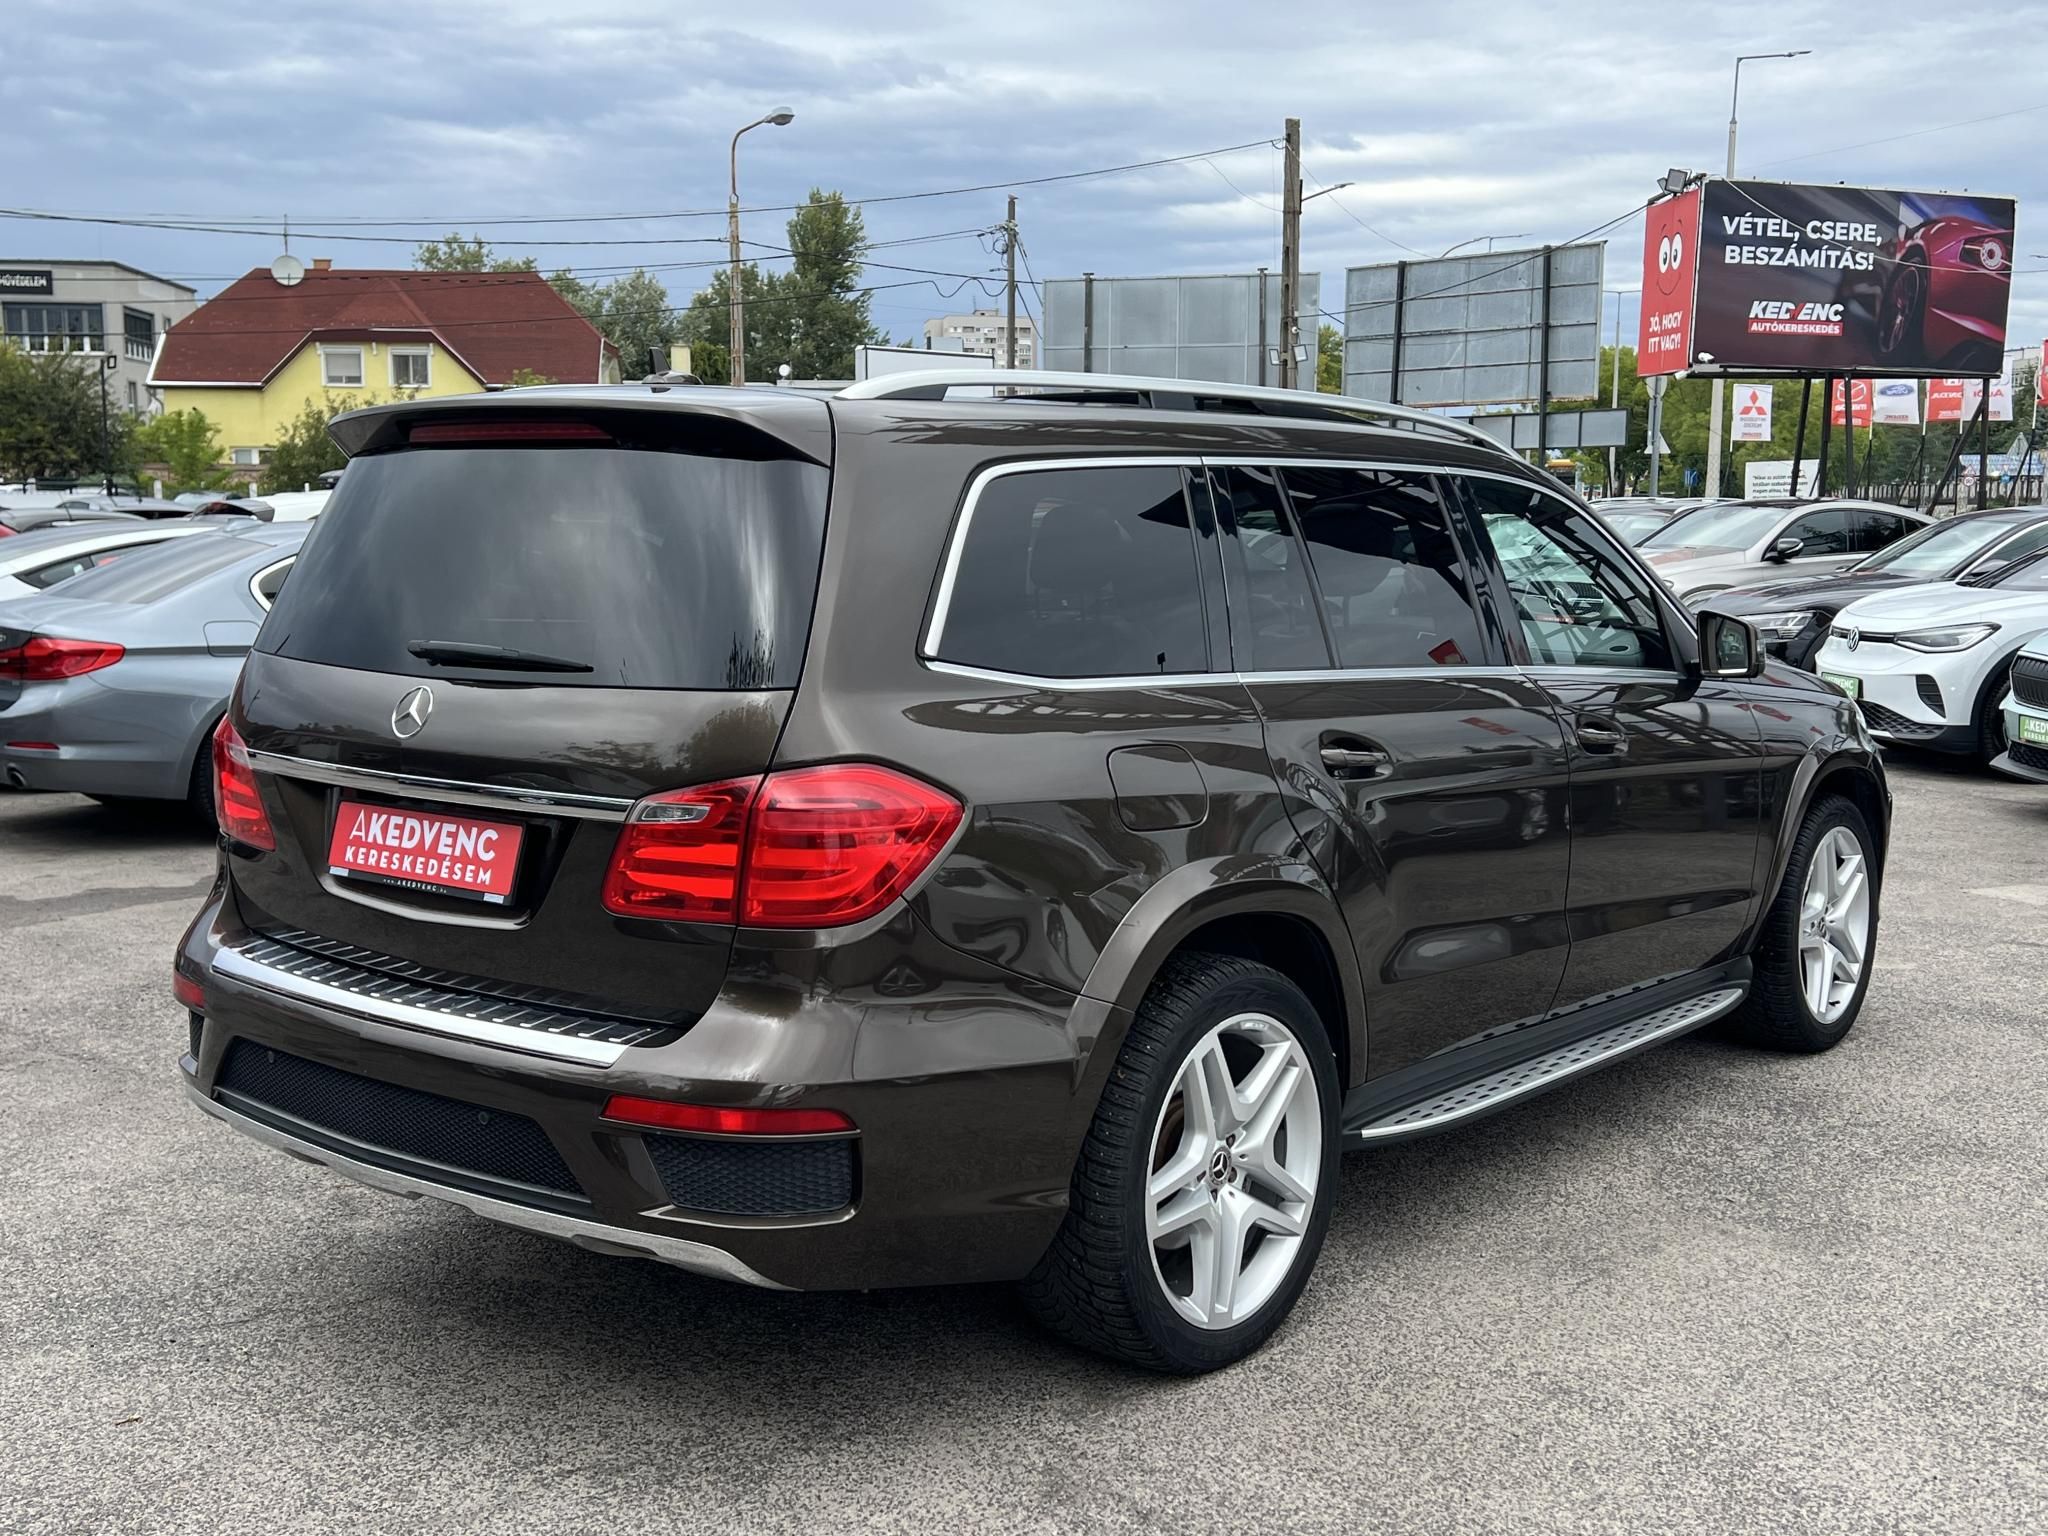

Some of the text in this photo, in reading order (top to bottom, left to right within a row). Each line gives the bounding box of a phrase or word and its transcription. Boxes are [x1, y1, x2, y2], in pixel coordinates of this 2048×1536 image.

[1722, 212, 1883, 247] VÉTEL, CSERE,
[1724, 243, 1875, 271] BESZÁMÍTÁS!
[1649, 310, 1683, 334] JÓ, HOGY
[1749, 300, 1845, 322] KEDVENC
[1751, 321, 1840, 335] AUTÓKERESKEDÉS
[1648, 332, 1682, 353] ITT VAGY!
[2024, 719, 2048, 734] AKED
[345, 845, 492, 886] KERESKEDÉSEM
